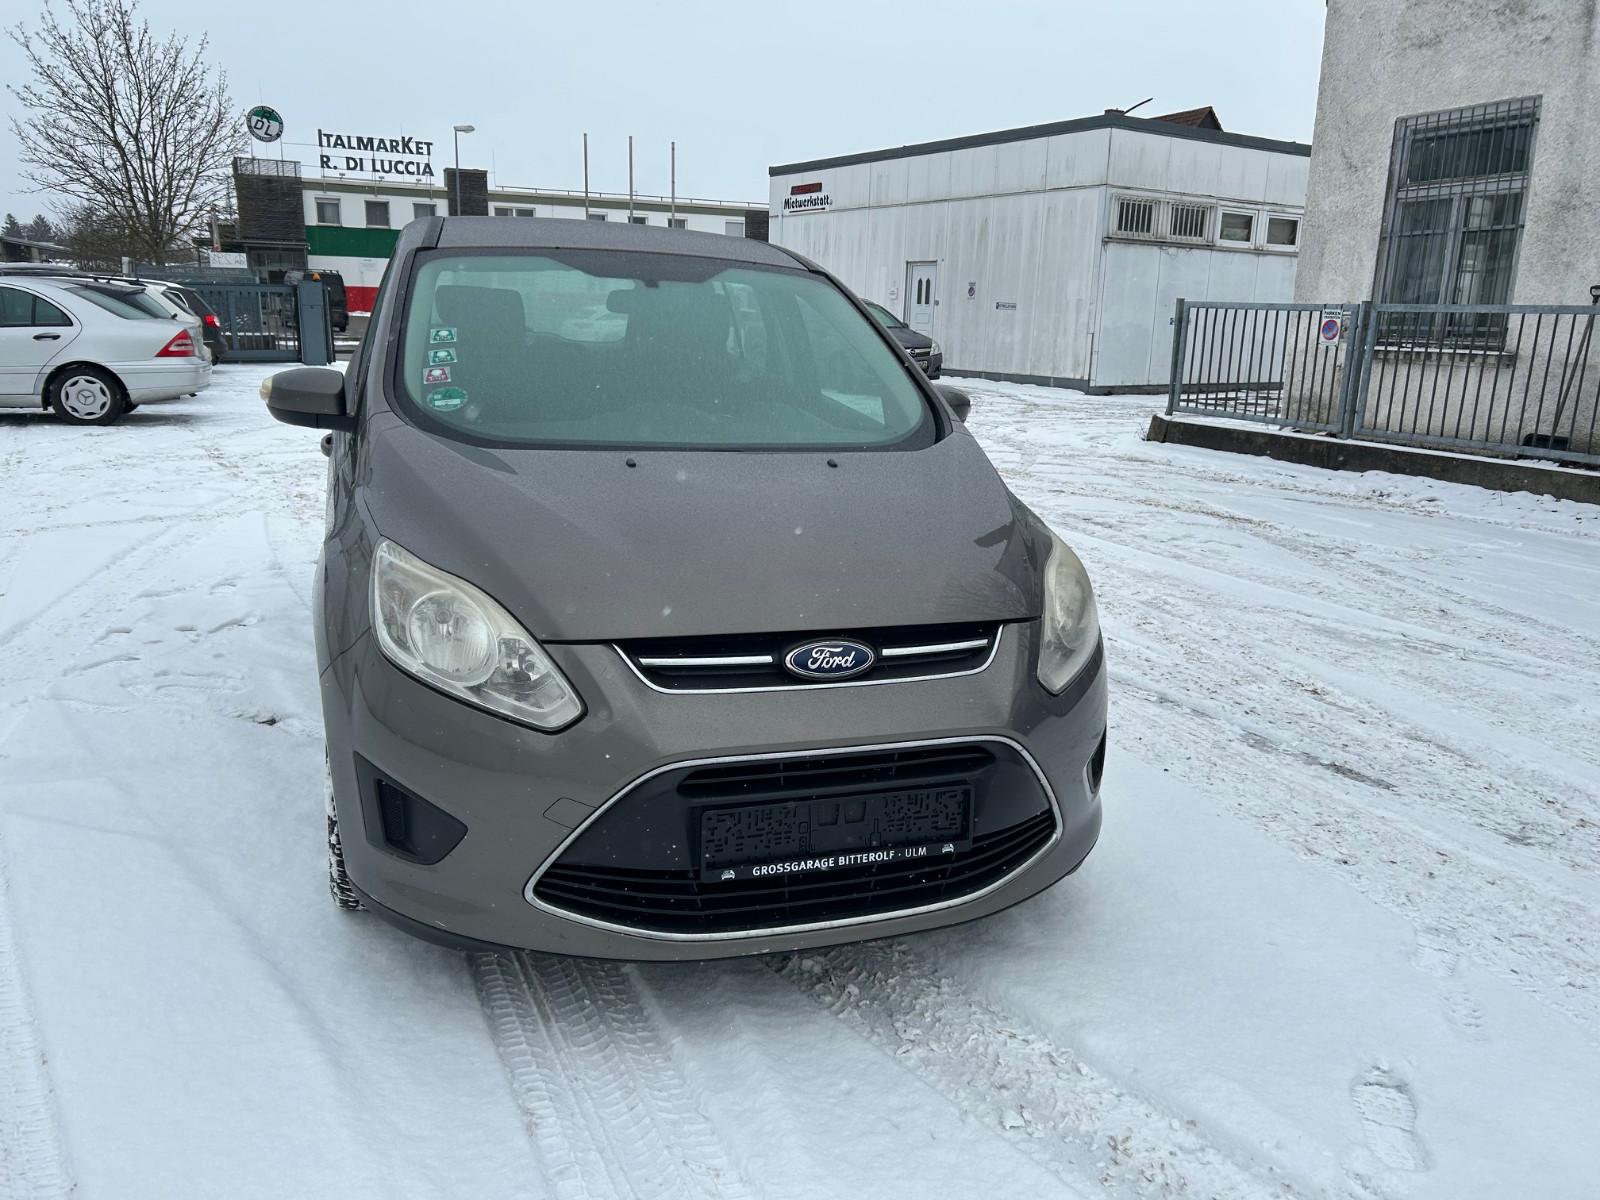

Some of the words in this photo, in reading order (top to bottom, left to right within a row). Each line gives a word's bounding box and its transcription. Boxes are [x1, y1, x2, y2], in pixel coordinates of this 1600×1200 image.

[319, 154, 338, 170] R.
[345, 156, 364, 172] DI
[371, 158, 435, 177] LUCCIA
[807, 647, 856, 670] Ford
[752, 857, 835, 876] GROSSGARAGE
[838, 850, 895, 866] BITTEROLF
[905, 846, 928, 858] ULM
